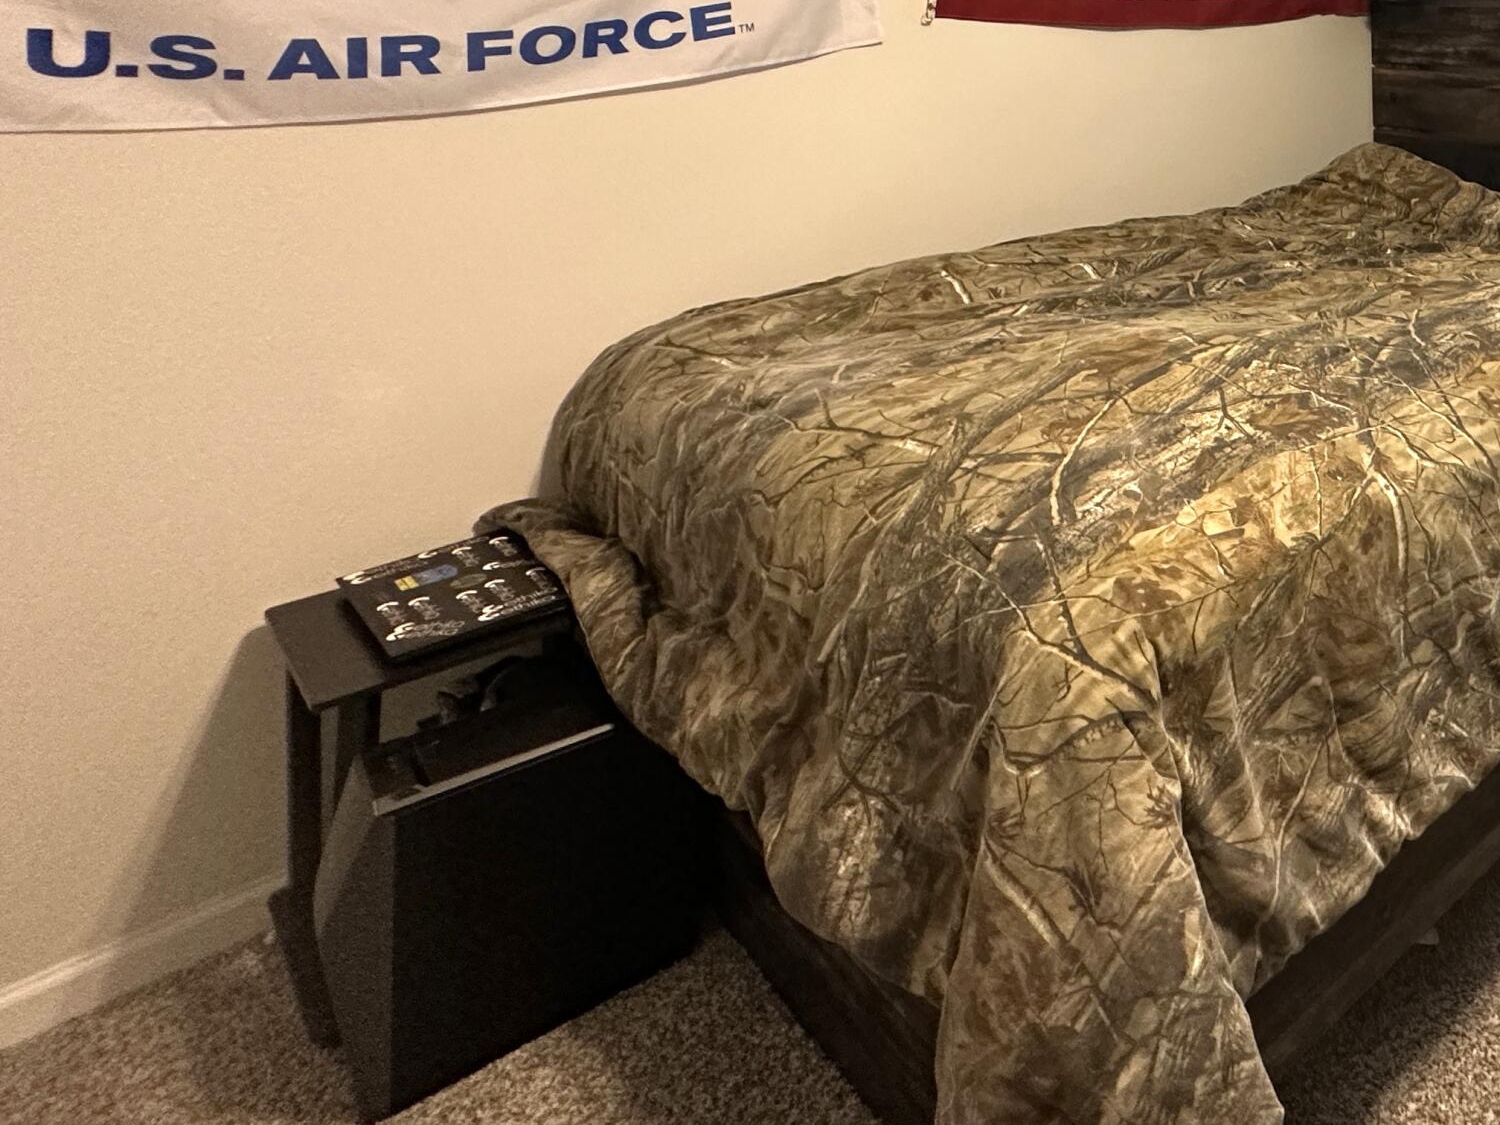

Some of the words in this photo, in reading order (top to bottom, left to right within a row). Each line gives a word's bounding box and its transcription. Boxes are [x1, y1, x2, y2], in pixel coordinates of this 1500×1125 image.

[26, 28, 245, 80] U.S.
[266, 34, 442, 81] AIR
[467, 1, 736, 73] FORCE
